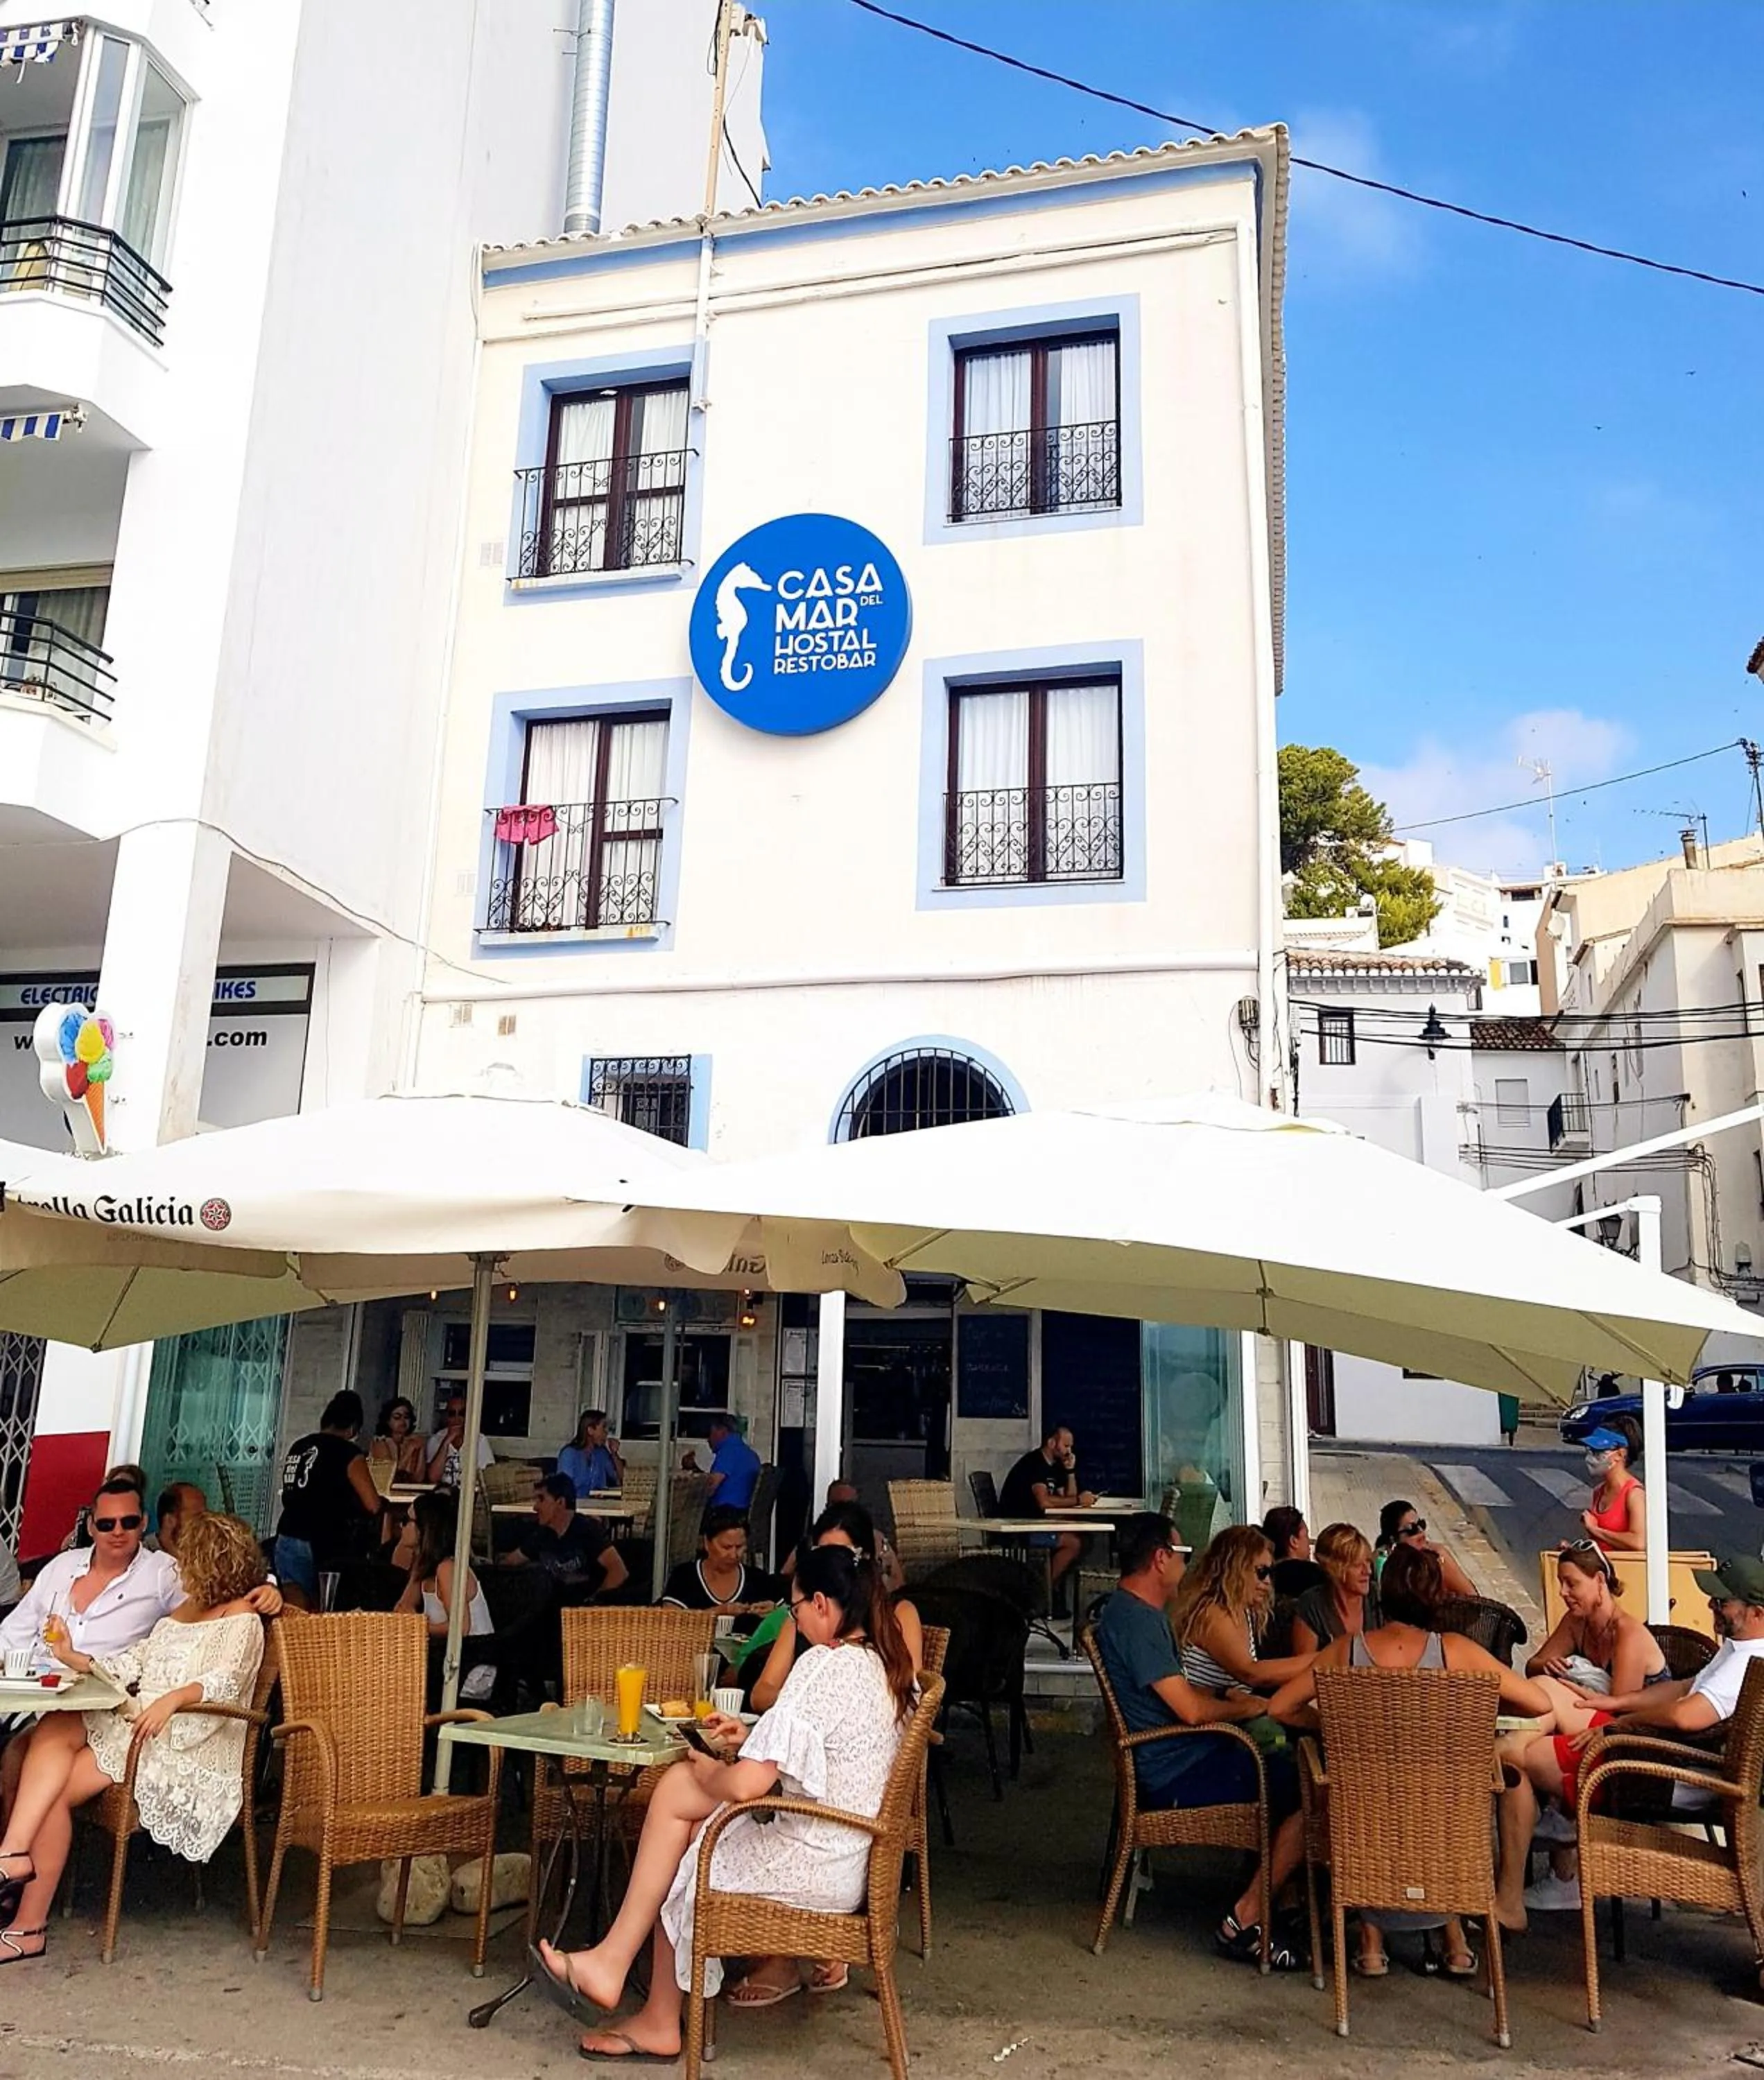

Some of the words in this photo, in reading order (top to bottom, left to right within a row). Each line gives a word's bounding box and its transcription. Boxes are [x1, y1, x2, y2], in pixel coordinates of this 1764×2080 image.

[777, 563, 884, 600] CASA
[775, 598, 858, 633] MAR
[860, 596, 883, 607] DEL
[775, 628, 877, 657] HOSTAL
[773, 652, 876, 675] RESTOBAR
[215, 981, 256, 999] IKES
[94, 1195, 193, 1225] Galicia
